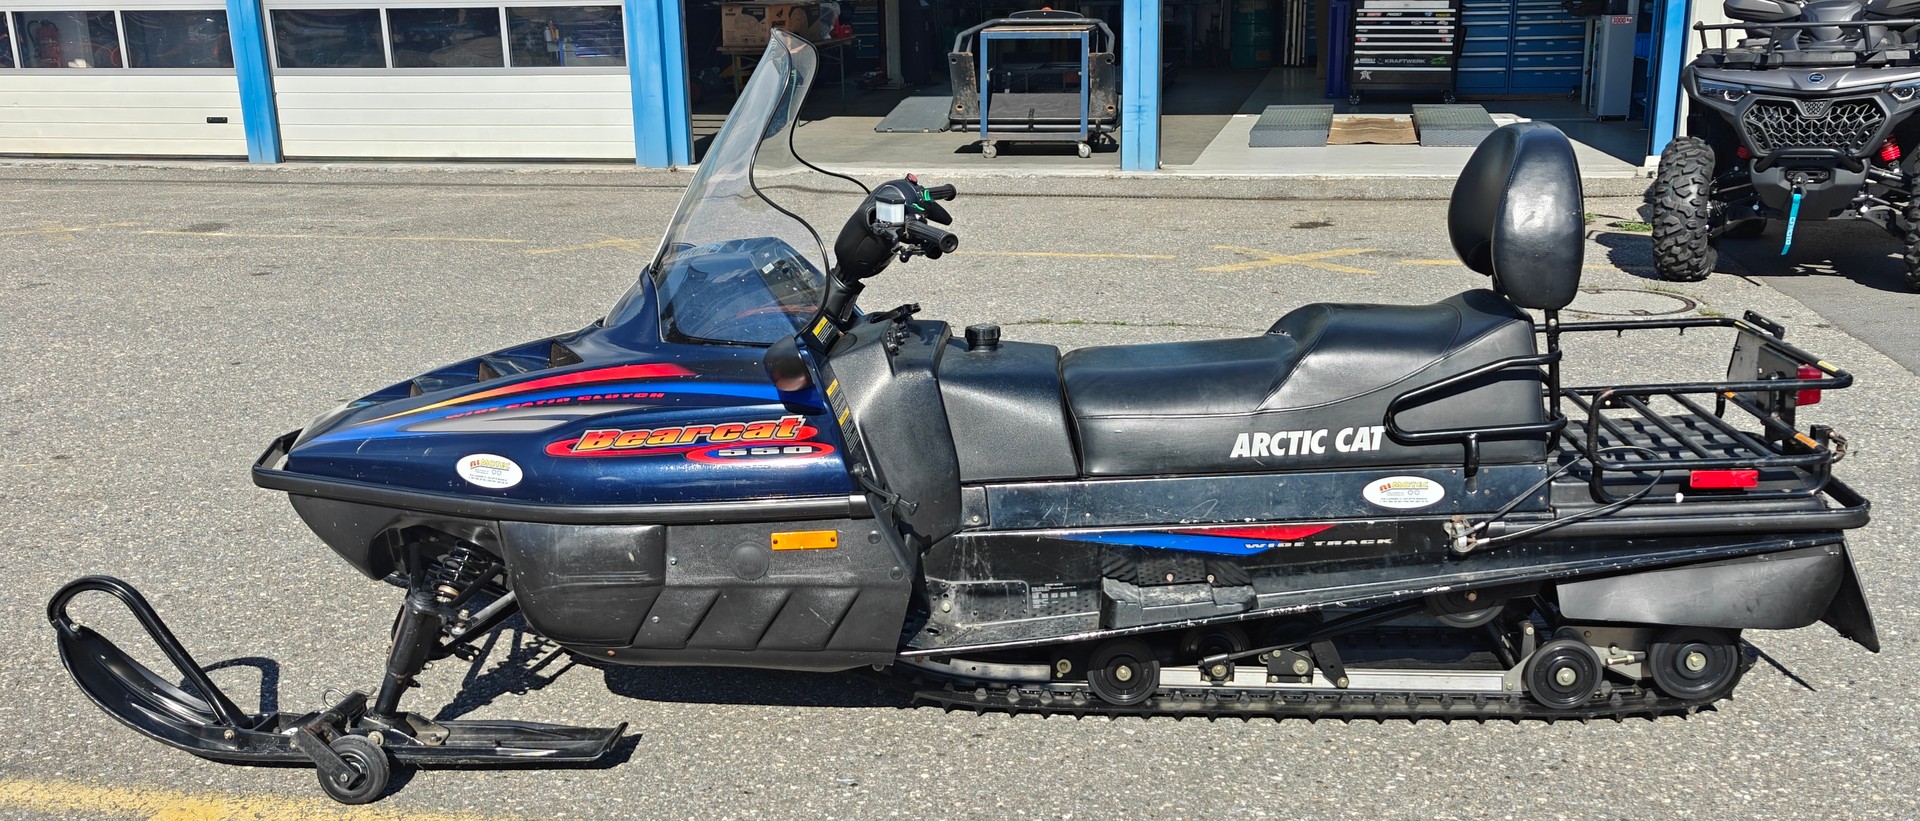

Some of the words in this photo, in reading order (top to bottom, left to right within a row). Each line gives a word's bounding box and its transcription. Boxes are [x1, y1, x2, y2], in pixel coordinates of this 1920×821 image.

[571, 415, 807, 452] Bearcat
[1229, 429, 1328, 458] ARCTIC
[1335, 425, 1386, 453] CAT
[718, 446, 812, 456] 550
[1313, 538, 1395, 547] TRACK
